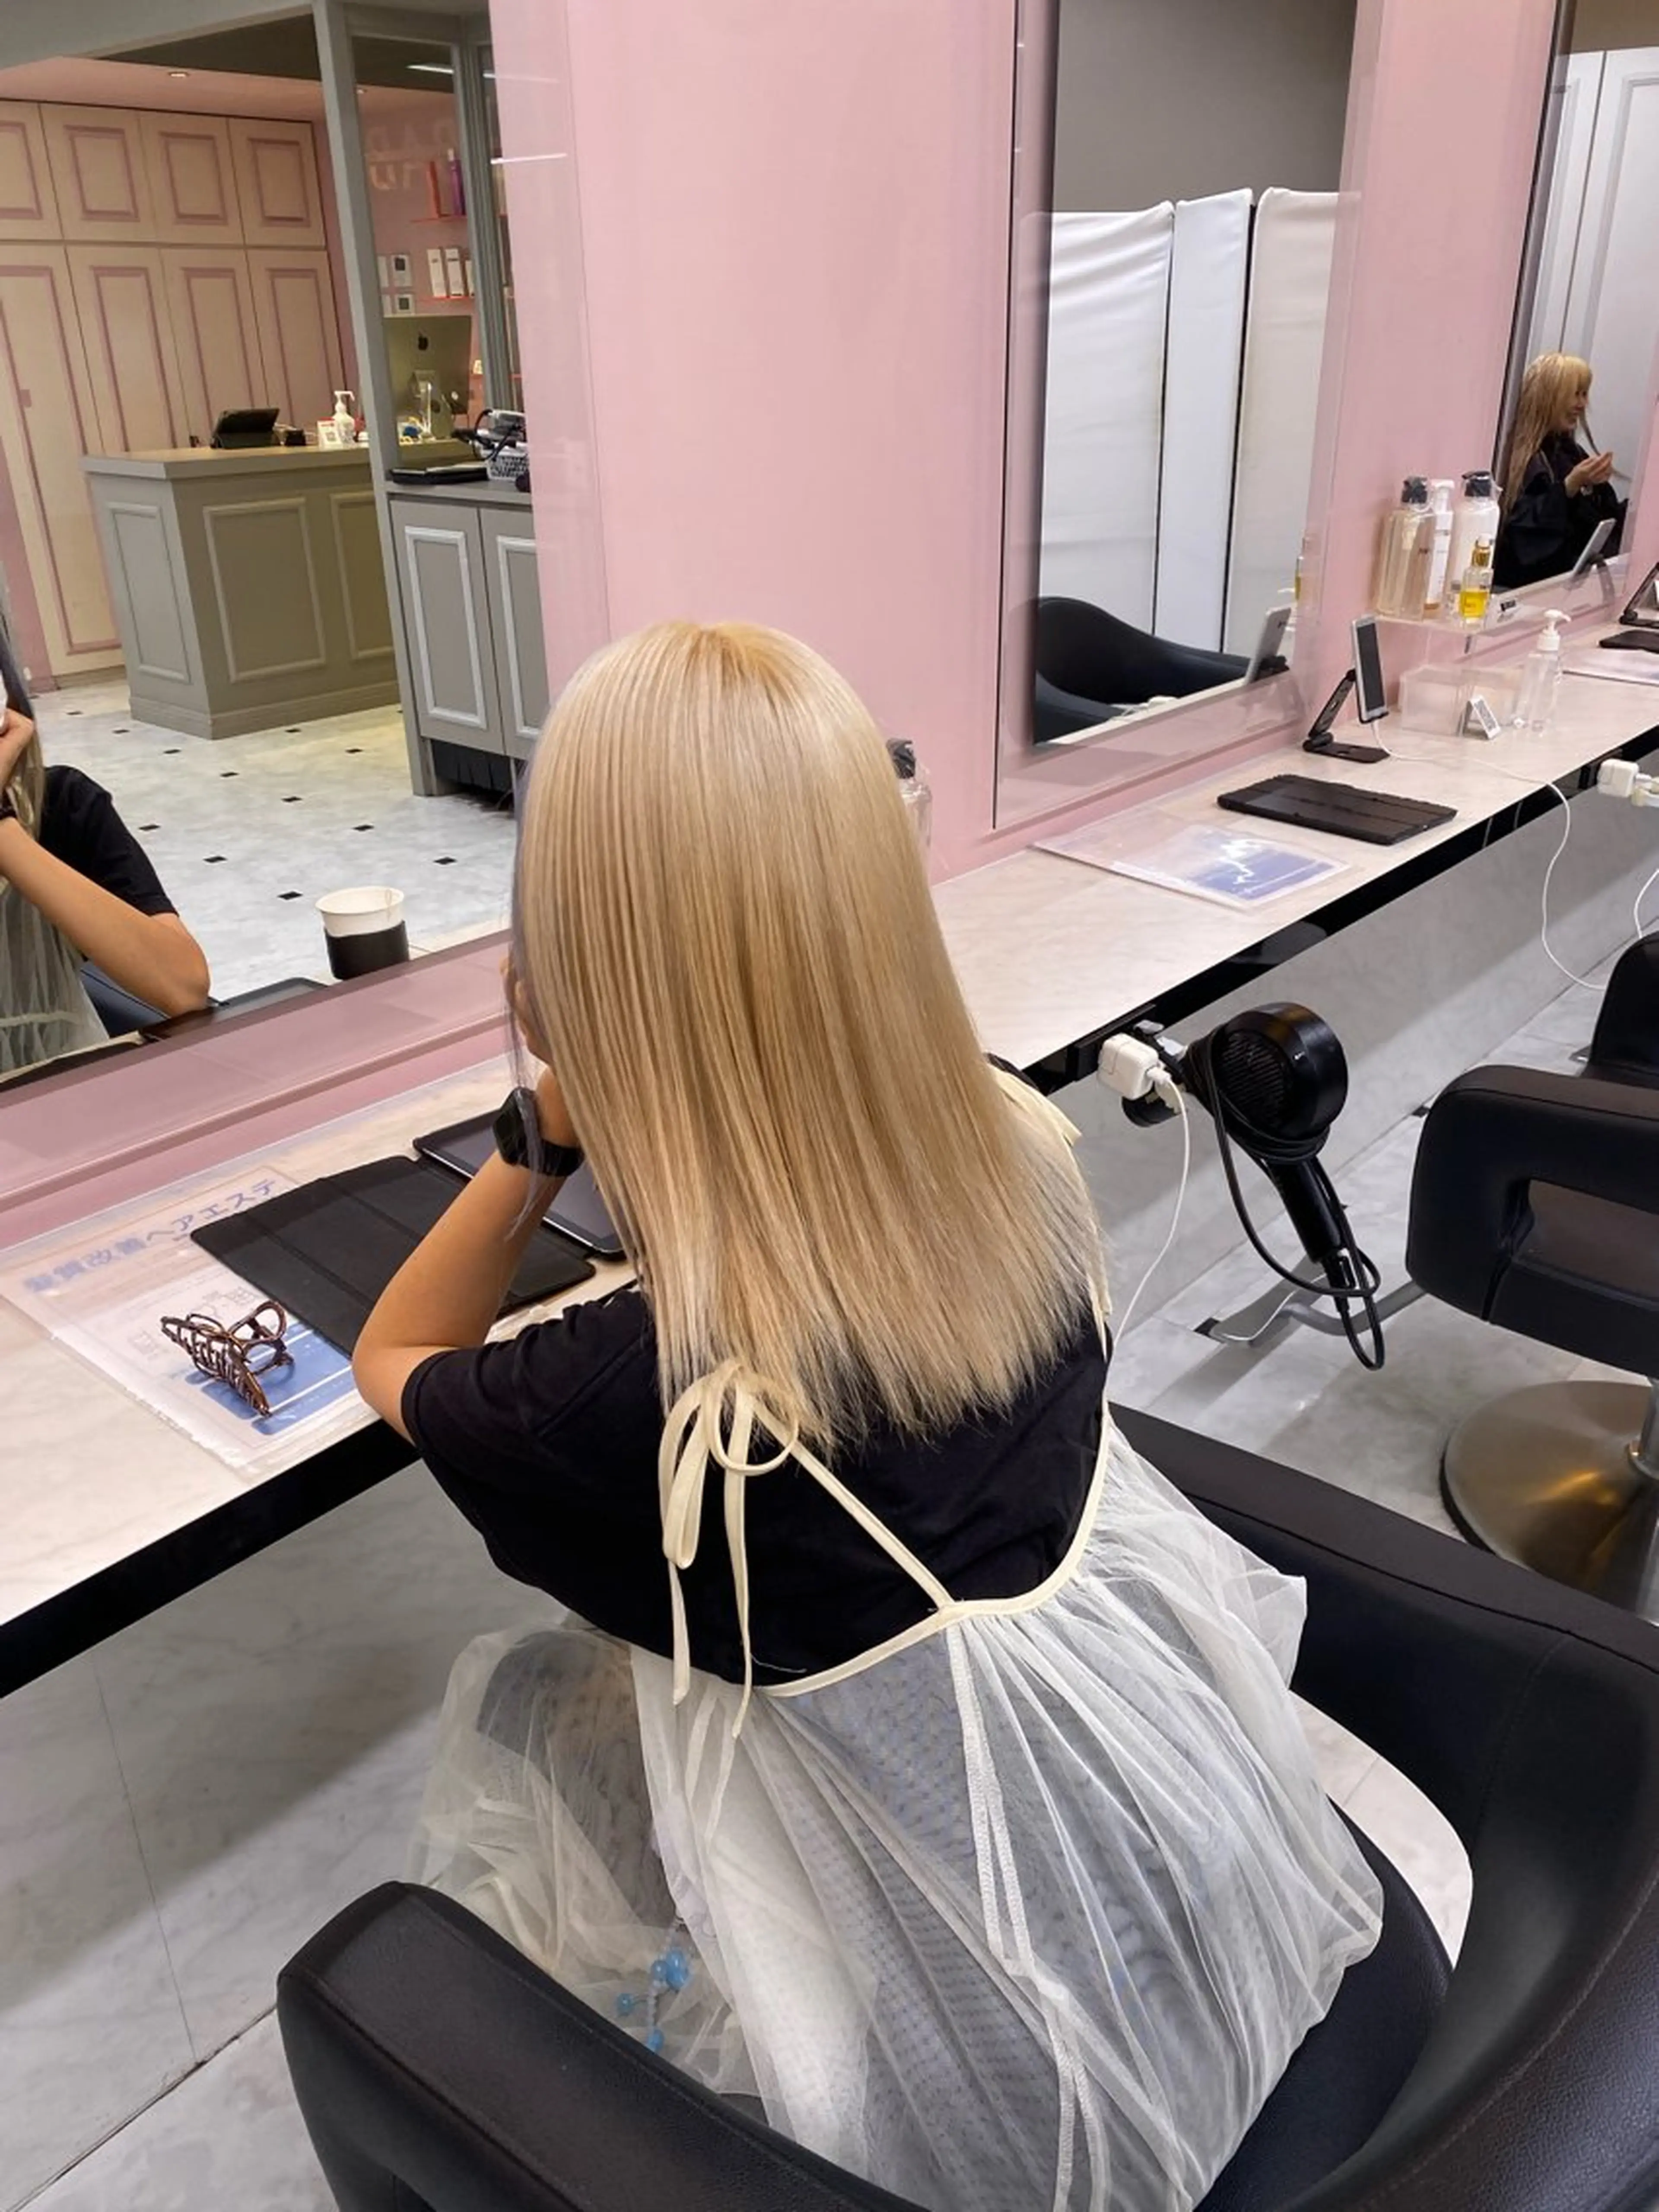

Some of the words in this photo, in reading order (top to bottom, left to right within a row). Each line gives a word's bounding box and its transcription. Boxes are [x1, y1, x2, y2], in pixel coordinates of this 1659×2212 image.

[25, 1179, 276, 1292] 改ヘアエステ
